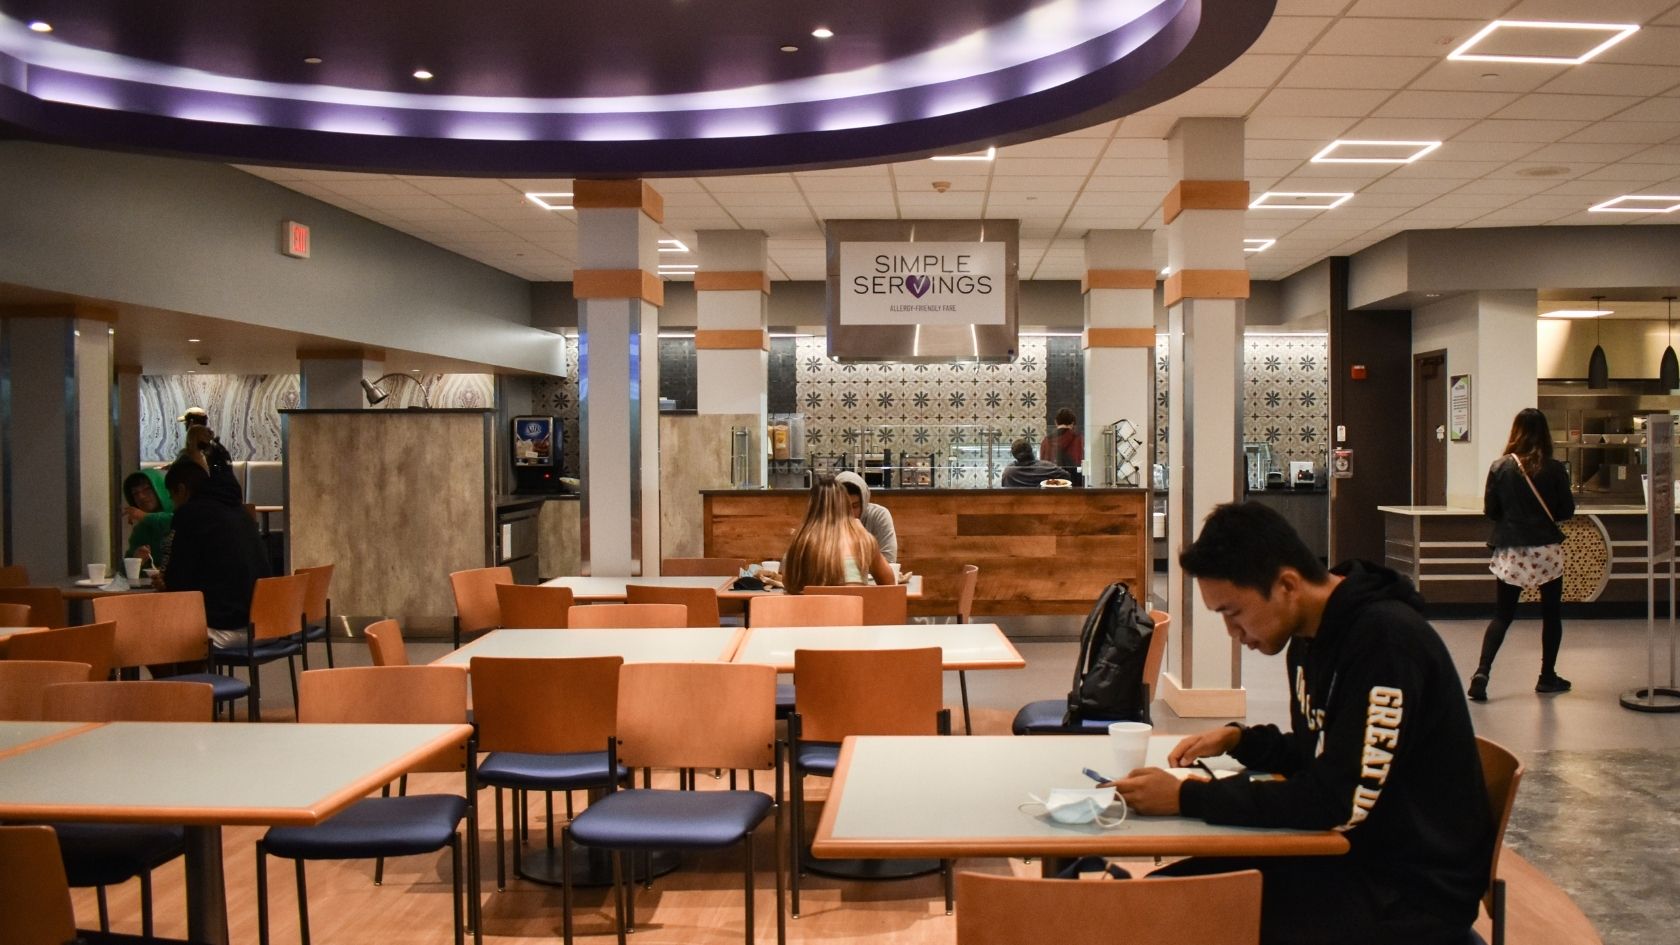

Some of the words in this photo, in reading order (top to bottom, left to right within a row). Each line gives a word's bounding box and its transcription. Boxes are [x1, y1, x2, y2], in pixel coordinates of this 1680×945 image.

[875, 255, 971, 274] SIMPLE
[854, 275, 993, 295] SERVINGS
[889, 304, 941, 312] ALLERGY-FRIENDLY
[942, 304, 957, 312] FARE
[1361, 686, 1403, 785] GREAT
